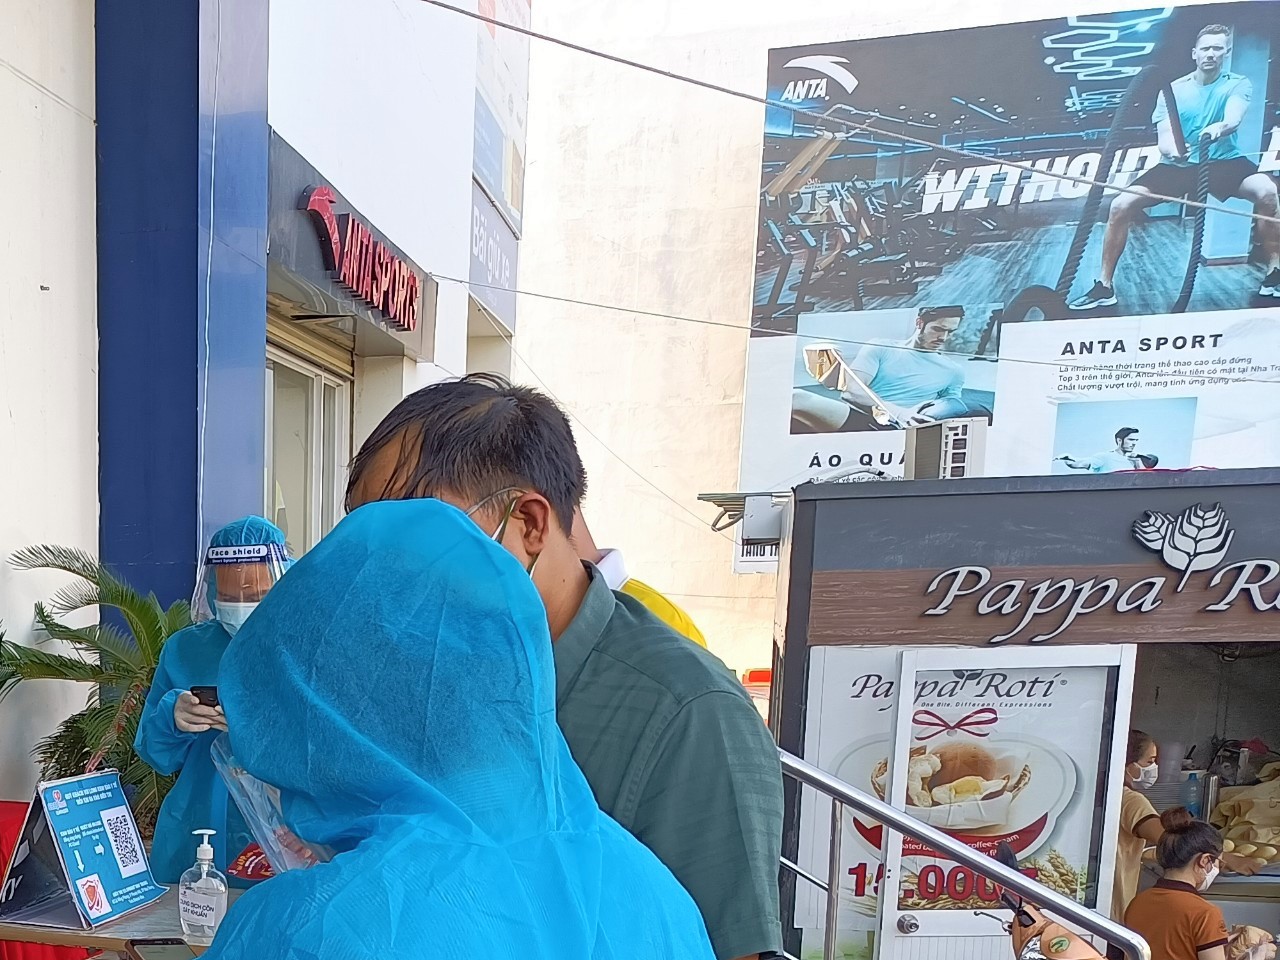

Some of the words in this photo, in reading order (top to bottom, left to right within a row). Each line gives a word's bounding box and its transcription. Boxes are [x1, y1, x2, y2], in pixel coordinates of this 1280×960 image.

[780, 78, 827, 102] ANTA
[1061, 339, 1127, 355] ANTA
[1139, 333, 1224, 351] SPORT
[1173, 359, 1192, 367] thao
[1144, 381, 1168, 389] mang
[809, 452, 842, 468] ÁO
[211, 549, 229, 557] Face
[232, 547, 261, 556] shield
[923, 565, 1167, 644] Pappa
[1205, 558, 1280, 613] R
[850, 672, 964, 712] Papa
[975, 672, 1063, 699] Roti
